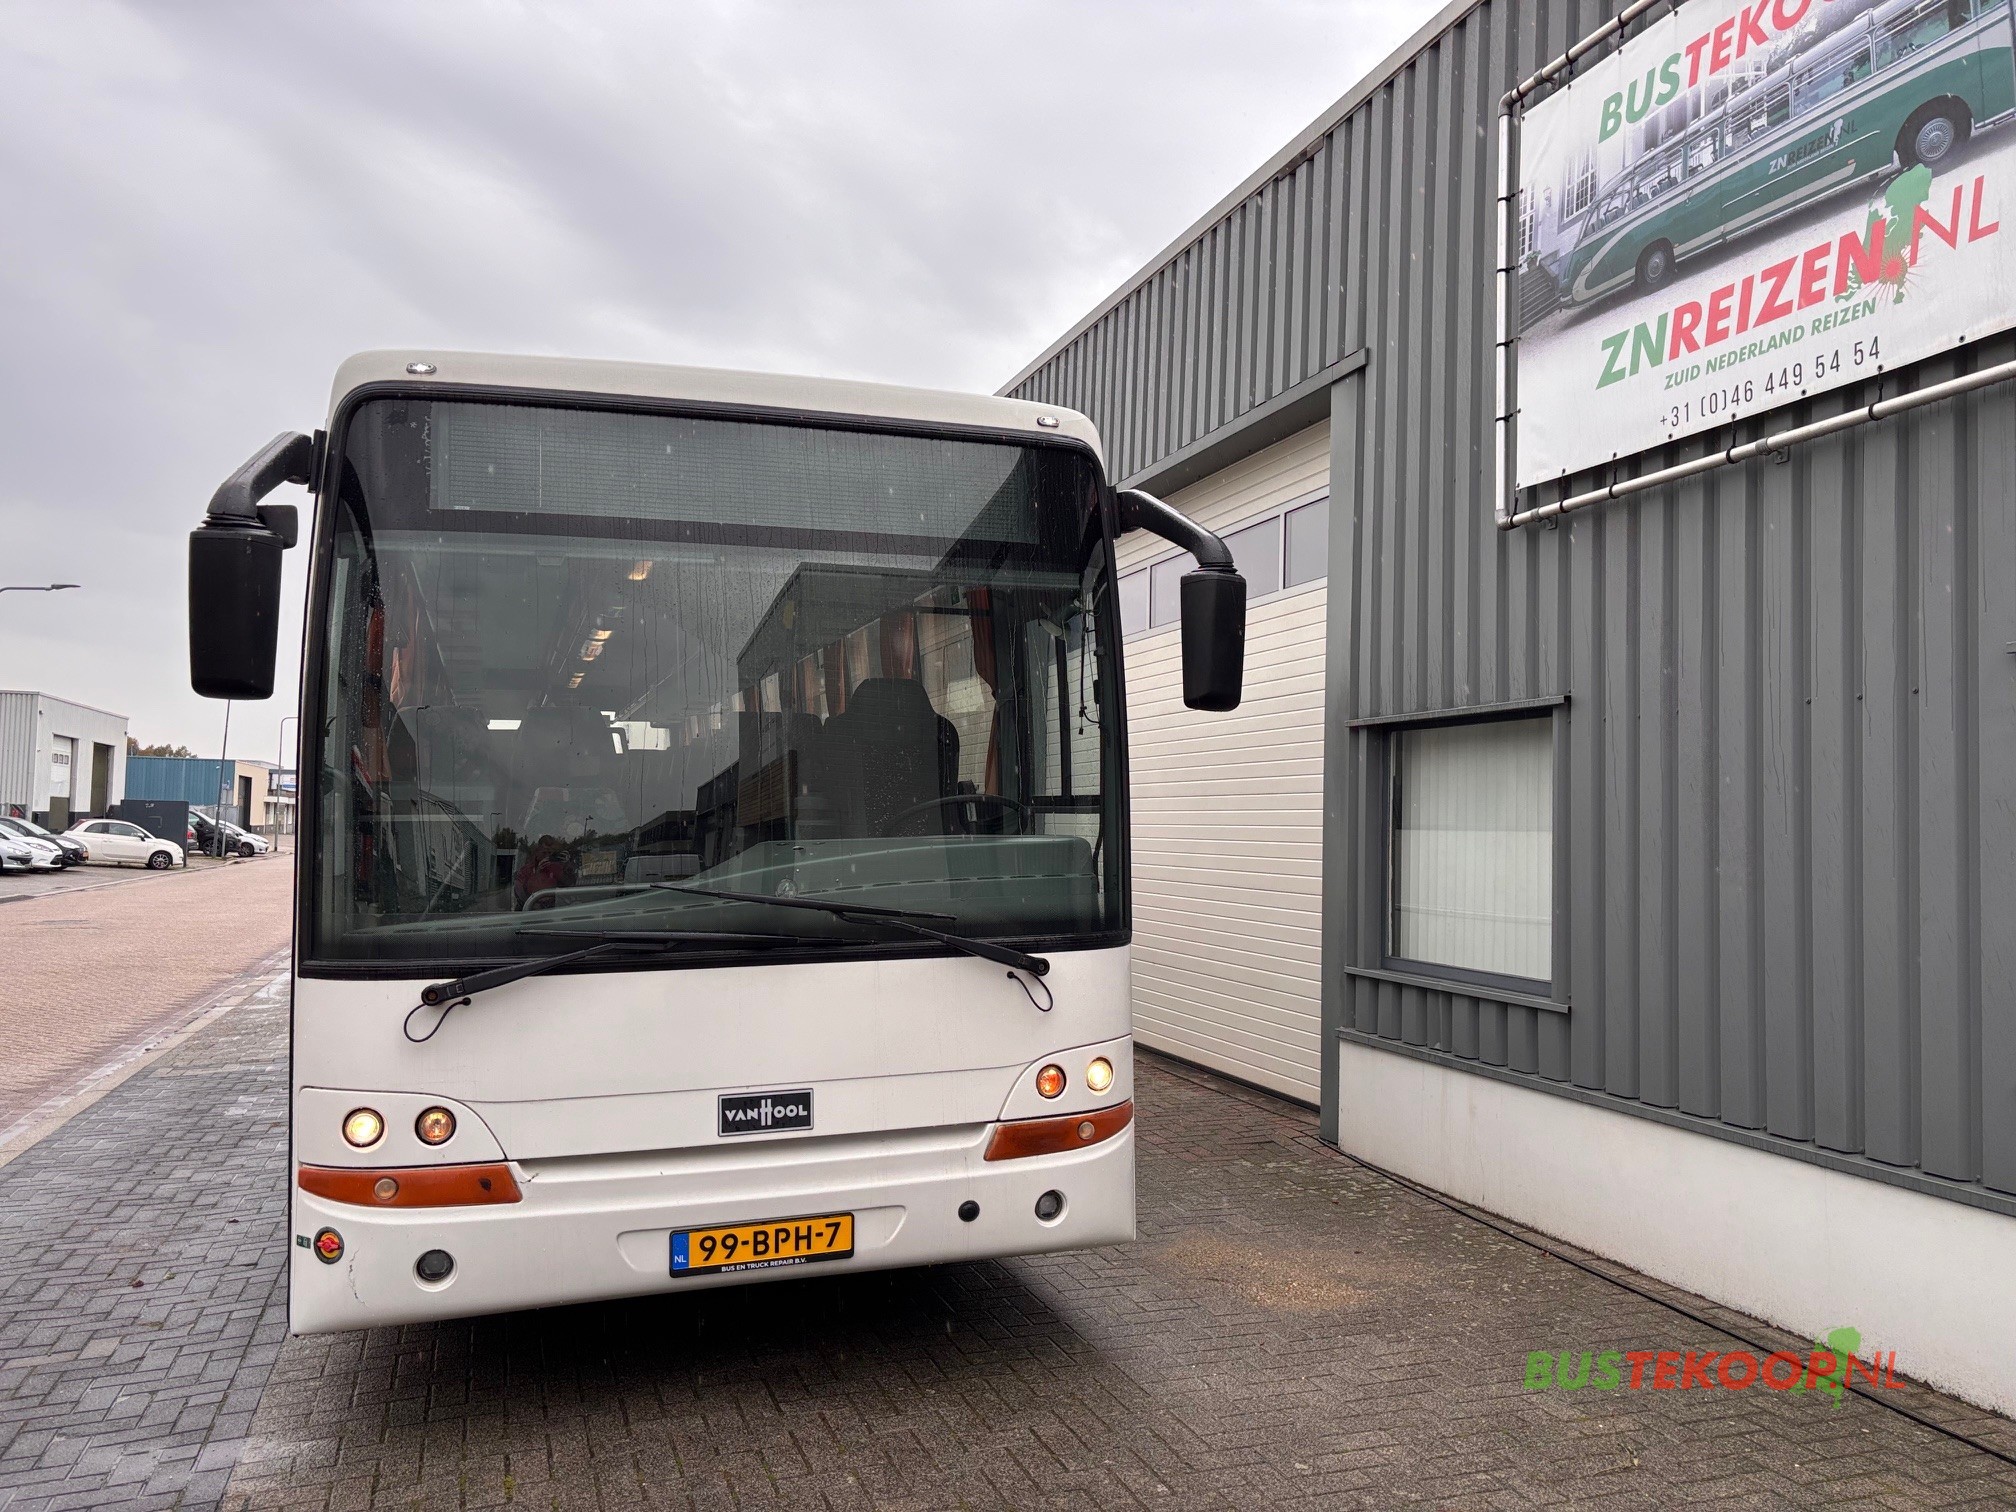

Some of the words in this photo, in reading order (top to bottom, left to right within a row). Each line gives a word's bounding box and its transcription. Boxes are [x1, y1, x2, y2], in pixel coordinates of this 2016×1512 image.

[1598, 0, 1838, 144] BUSTEKO
[1664, 363, 1701, 391] ZUID
[1706, 325, 1805, 376] NEDERLAND
[1810, 297, 1877, 336] REIZEN
[1660, 402, 1690, 427] +31
[1700, 380, 1754, 417] (0)46
[1765, 362, 1803, 395] 449
[1815, 349, 1841, 379] 54
[1854, 336, 1880, 366] 54
[674, 1254, 687, 1263] NL
[699, 1221, 842, 1262] 99-BPH-7
[769, 1259, 794, 1268] REPAIR
